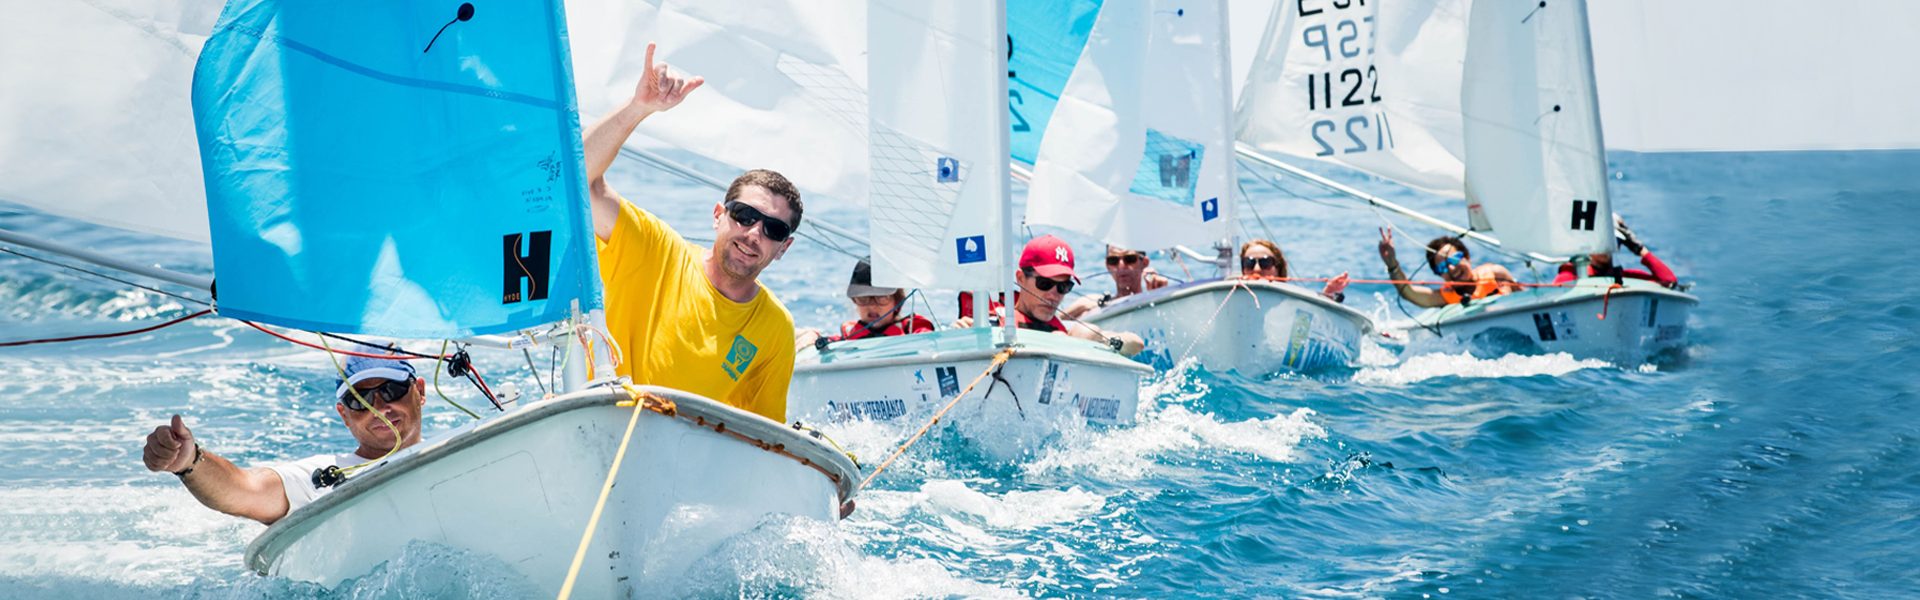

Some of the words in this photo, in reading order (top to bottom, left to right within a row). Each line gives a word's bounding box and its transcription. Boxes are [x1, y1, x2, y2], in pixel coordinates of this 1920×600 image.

[1308, 64, 1382, 111] 1122
[1571, 199, 1598, 231] H
[502, 230, 552, 305] H
